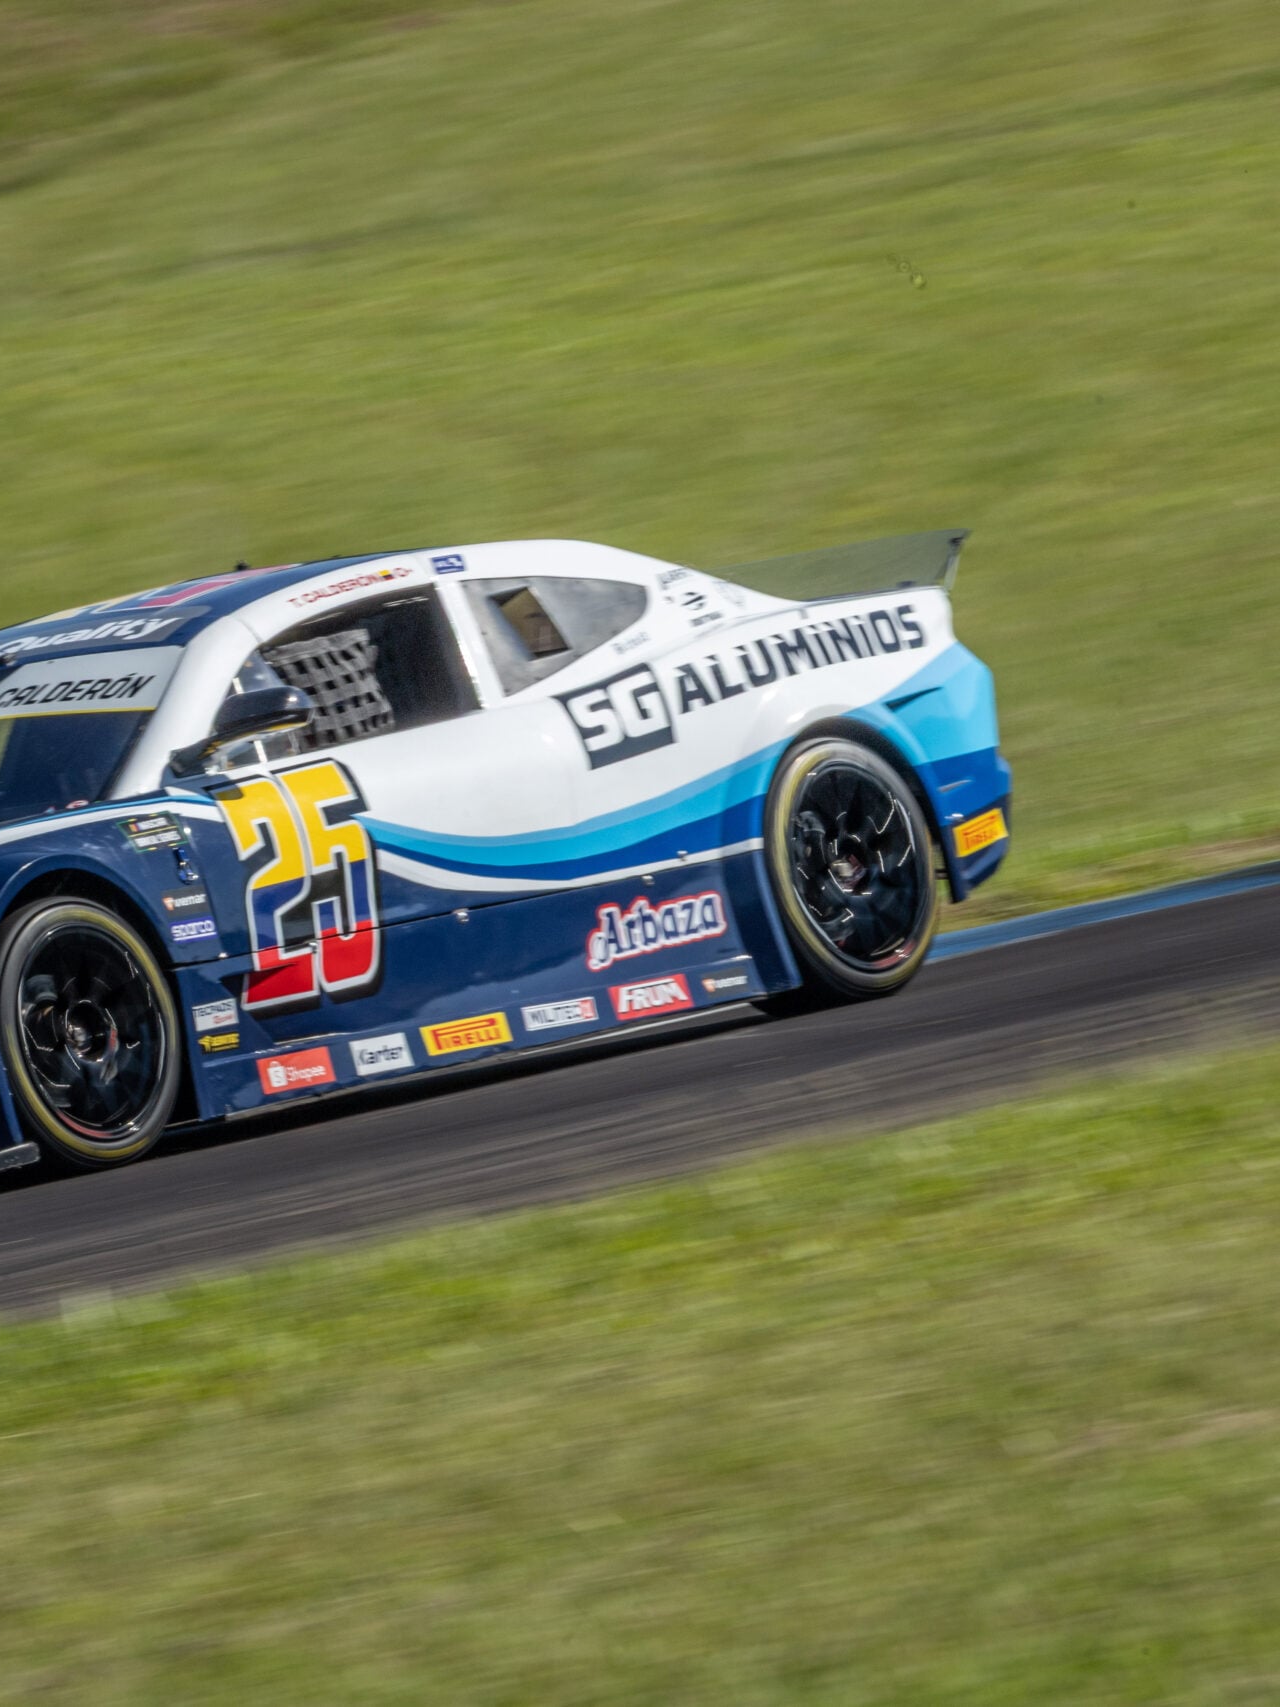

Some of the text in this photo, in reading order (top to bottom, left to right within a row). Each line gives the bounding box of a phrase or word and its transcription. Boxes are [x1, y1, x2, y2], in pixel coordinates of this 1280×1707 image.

[565, 670, 671, 753] SG
[210, 760, 380, 1012] 25
[588, 893, 724, 968] Arbaza
[430, 1017, 501, 1051] PIRELLI
